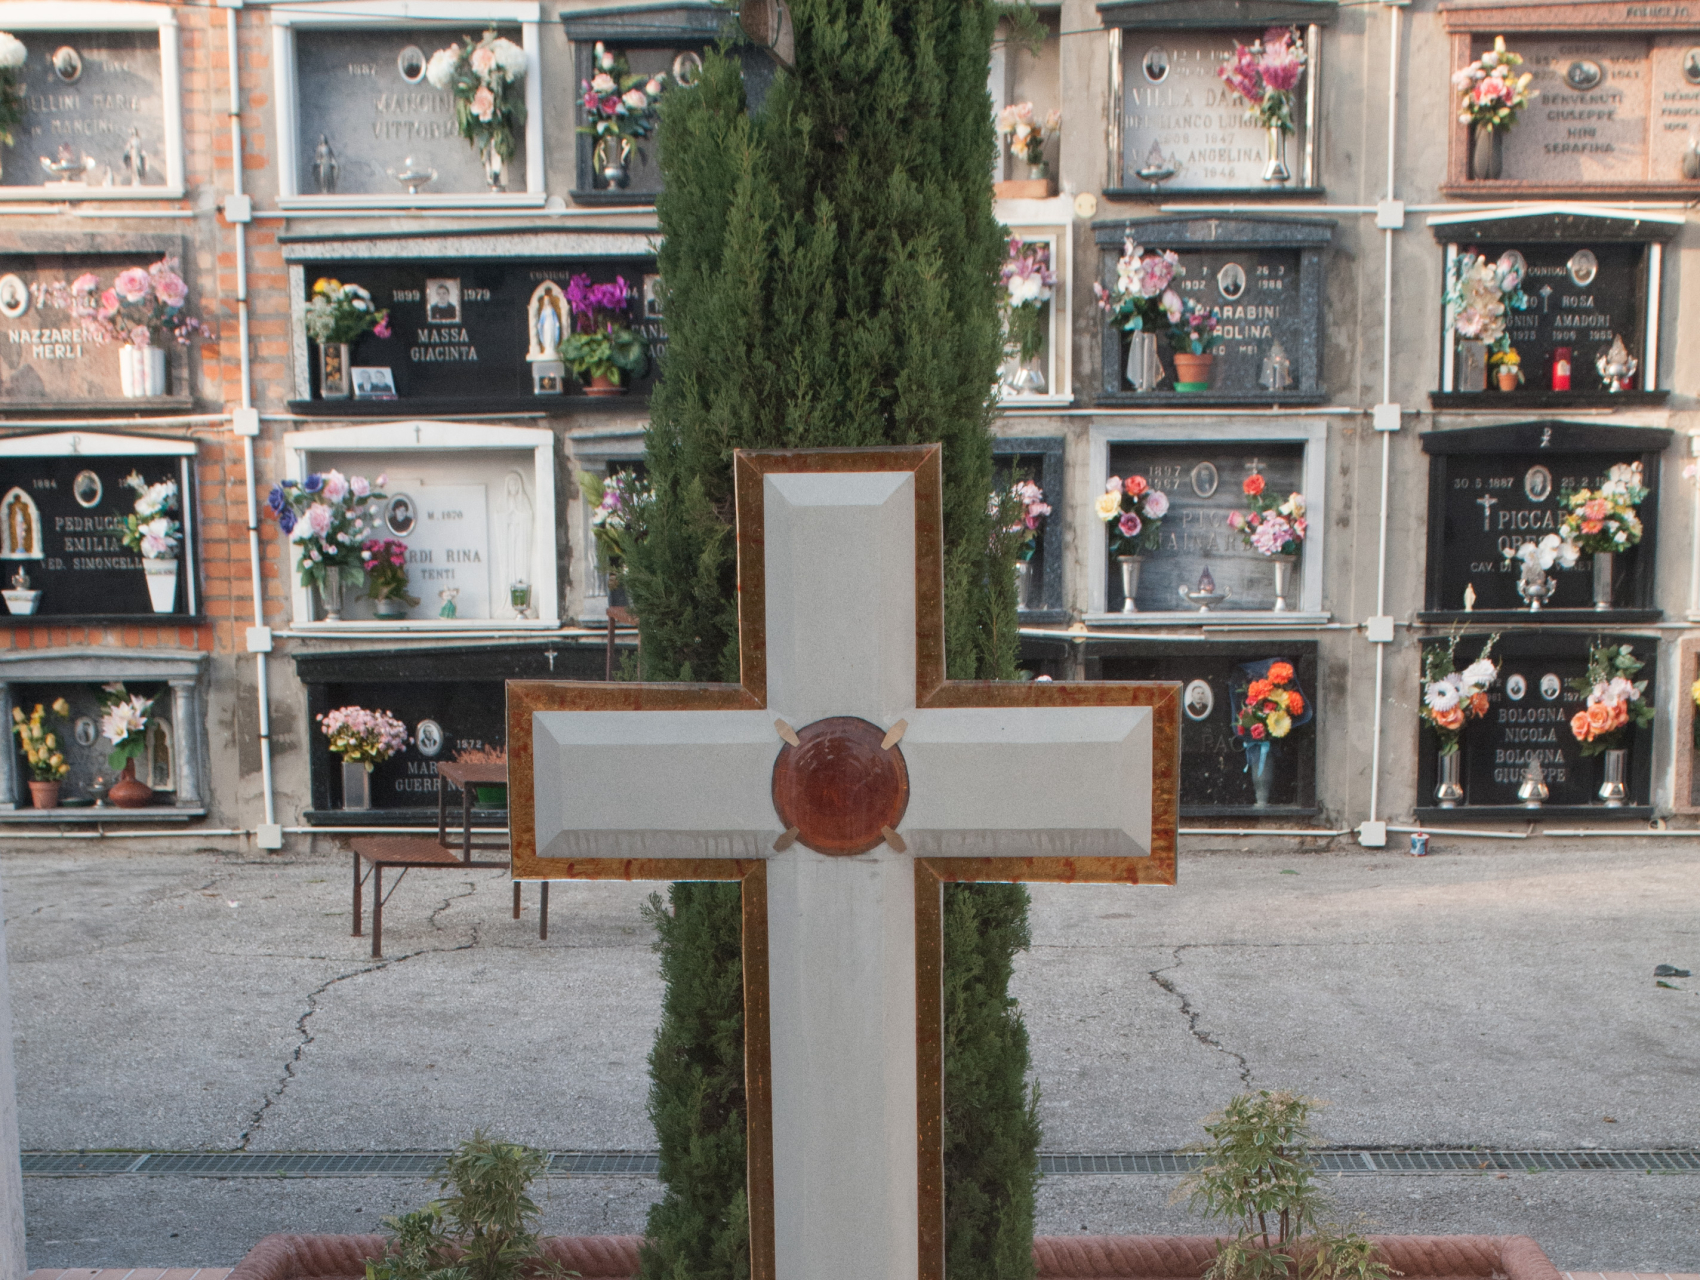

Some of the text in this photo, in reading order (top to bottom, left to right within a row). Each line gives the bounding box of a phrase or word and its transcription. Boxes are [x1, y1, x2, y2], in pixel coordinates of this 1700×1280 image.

[1132, 87, 1195, 107] VILLA
[1547, 109, 1616, 122] GIUSEPPE
[372, 119, 460, 140] VITTORIO
[1544, 141, 1616, 154] SERAFINA
[1188, 148, 1263, 163] ANGELINA
[1527, 265, 1568, 277] CONIUGI
[463, 289, 491, 301] 1979
[1562, 295, 1595, 308] ROSA
[1506, 314, 1539, 328] GNINI
[417, 328, 470, 344] MASSA
[1213, 325, 1273, 340] ROLINA
[32, 344, 83, 360] MERLI
[410, 346, 479, 362] GIACINTA
[64, 536, 120, 552] EMILIA
[73, 556, 144, 570] SIMONCELL
[406, 548, 482, 564] RDI RINA
[421, 568, 456, 580] TENTI
[1497, 707, 1567, 723] BOLOGNA
[1505, 727, 1558, 742] NICOLA
[1495, 748, 1566, 764] BOLOGNA
[407, 761, 438, 775] MAR
